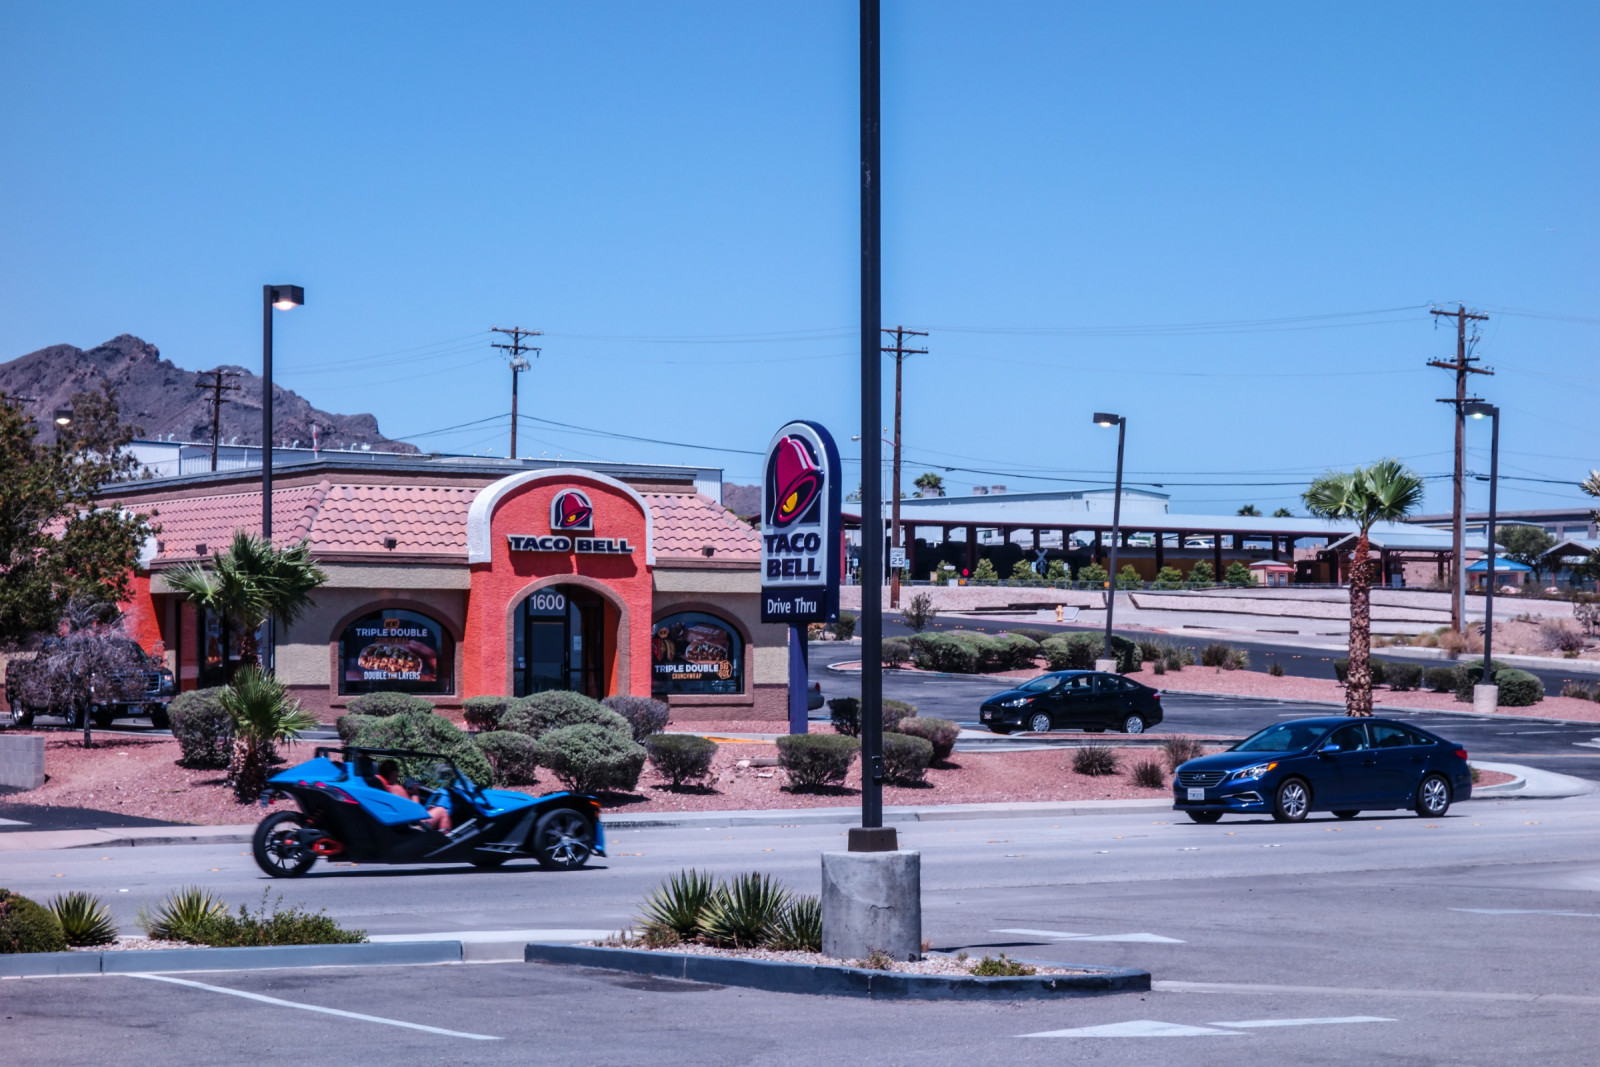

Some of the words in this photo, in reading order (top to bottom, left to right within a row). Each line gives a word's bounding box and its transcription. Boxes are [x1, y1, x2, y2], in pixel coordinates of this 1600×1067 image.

[508, 535, 571, 551] TACO
[575, 538, 635, 554] BELL
[764, 532, 821, 552] TACO
[767, 558, 821, 577] BELL
[531, 594, 565, 610] 1600
[767, 598, 791, 614] Drive
[795, 597, 817, 614] Thru
[356, 628, 388, 637] TRIPLE
[390, 628, 428, 637] DOUBLE
[364, 671, 386, 680] DOUBLE
[398, 671, 421, 680] LAYERS
[654, 664, 684, 673] TRIPLE
[686, 664, 718, 672] DOUBLE
